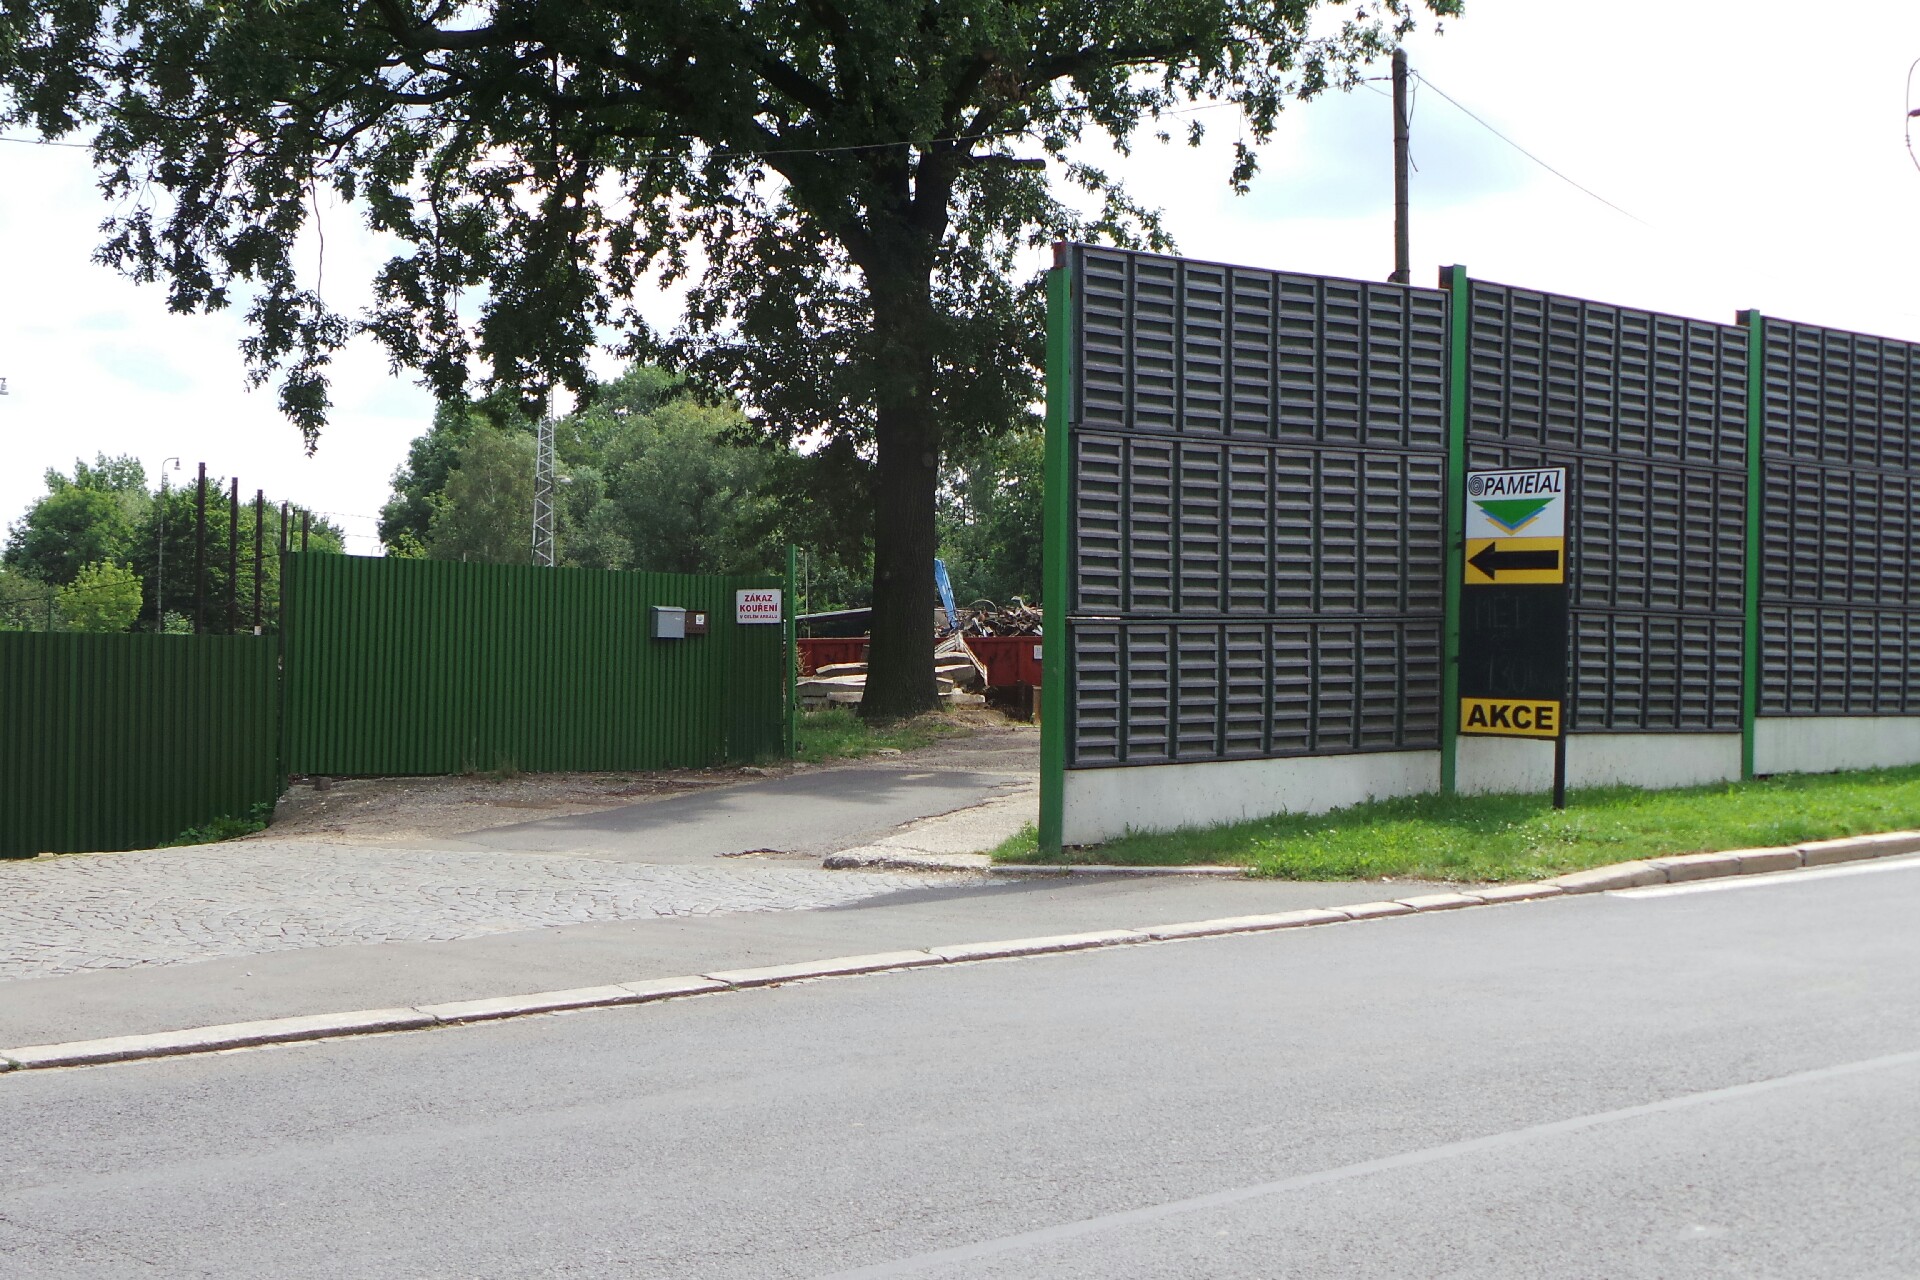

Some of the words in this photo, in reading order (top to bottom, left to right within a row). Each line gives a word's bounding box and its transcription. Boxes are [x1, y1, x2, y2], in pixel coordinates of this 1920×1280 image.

[1484, 471, 1561, 496] PAMETAL
[744, 593, 772, 602] ZÁKAZ
[740, 603, 777, 612] KOUŘENÍ
[1467, 704, 1554, 730] AKCE
